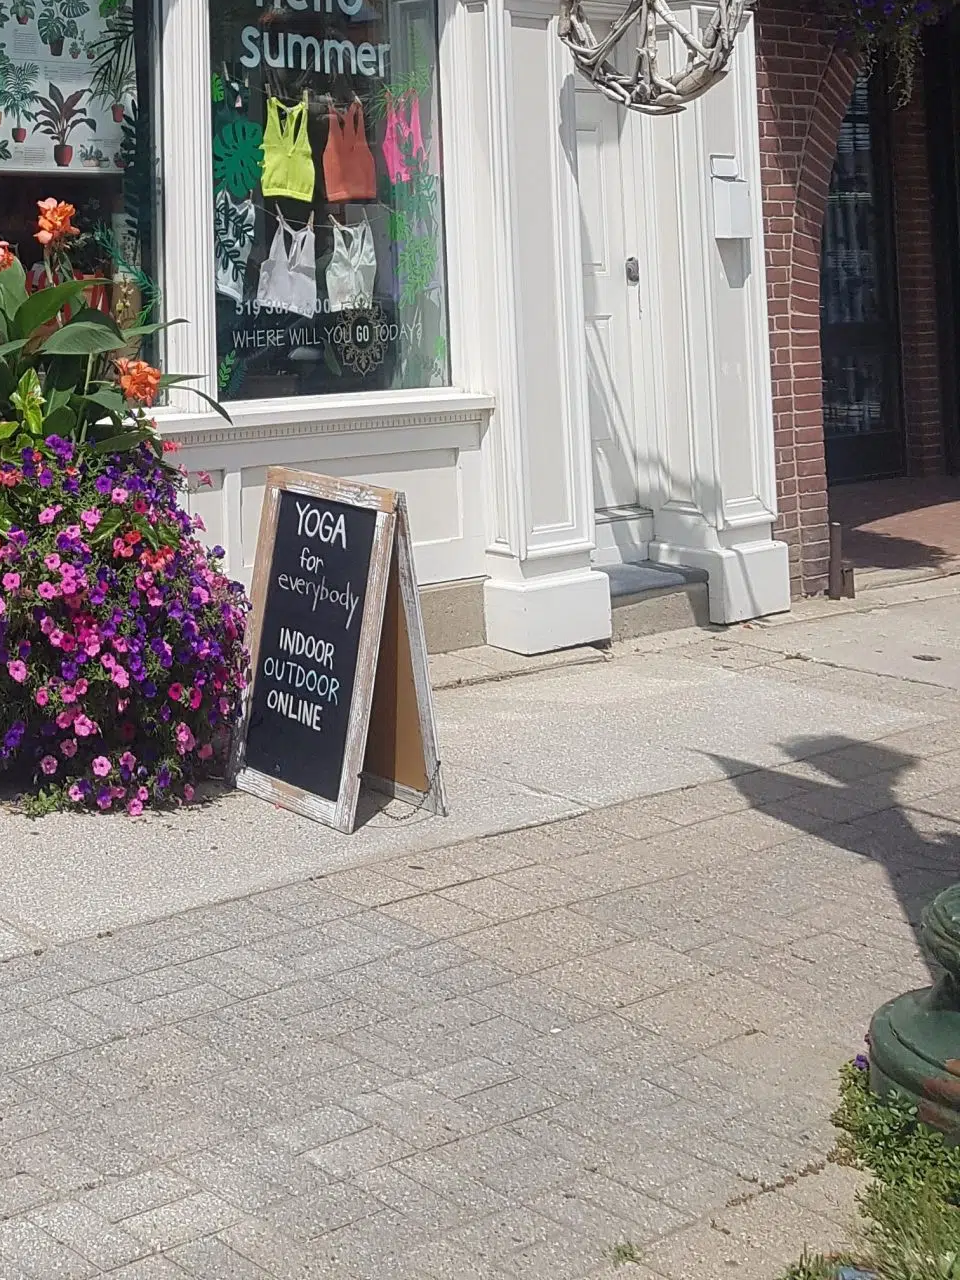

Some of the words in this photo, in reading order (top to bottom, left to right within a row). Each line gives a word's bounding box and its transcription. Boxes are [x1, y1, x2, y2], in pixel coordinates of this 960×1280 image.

[239, 25, 391, 78] summer
[232, 328, 285, 348] WHERE
[290, 326, 321, 345] WILL
[324, 327, 352, 344] YOU
[356, 324, 369, 342] GO
[373, 322, 423, 347] TODAY?
[296, 501, 347, 549] YOGA
[299, 547, 324, 571] for
[278, 573, 360, 630] everybody
[279, 627, 335, 670] INDOOR
[264, 657, 340, 706] OUTDOOR
[267, 689, 324, 732] ONLINE
